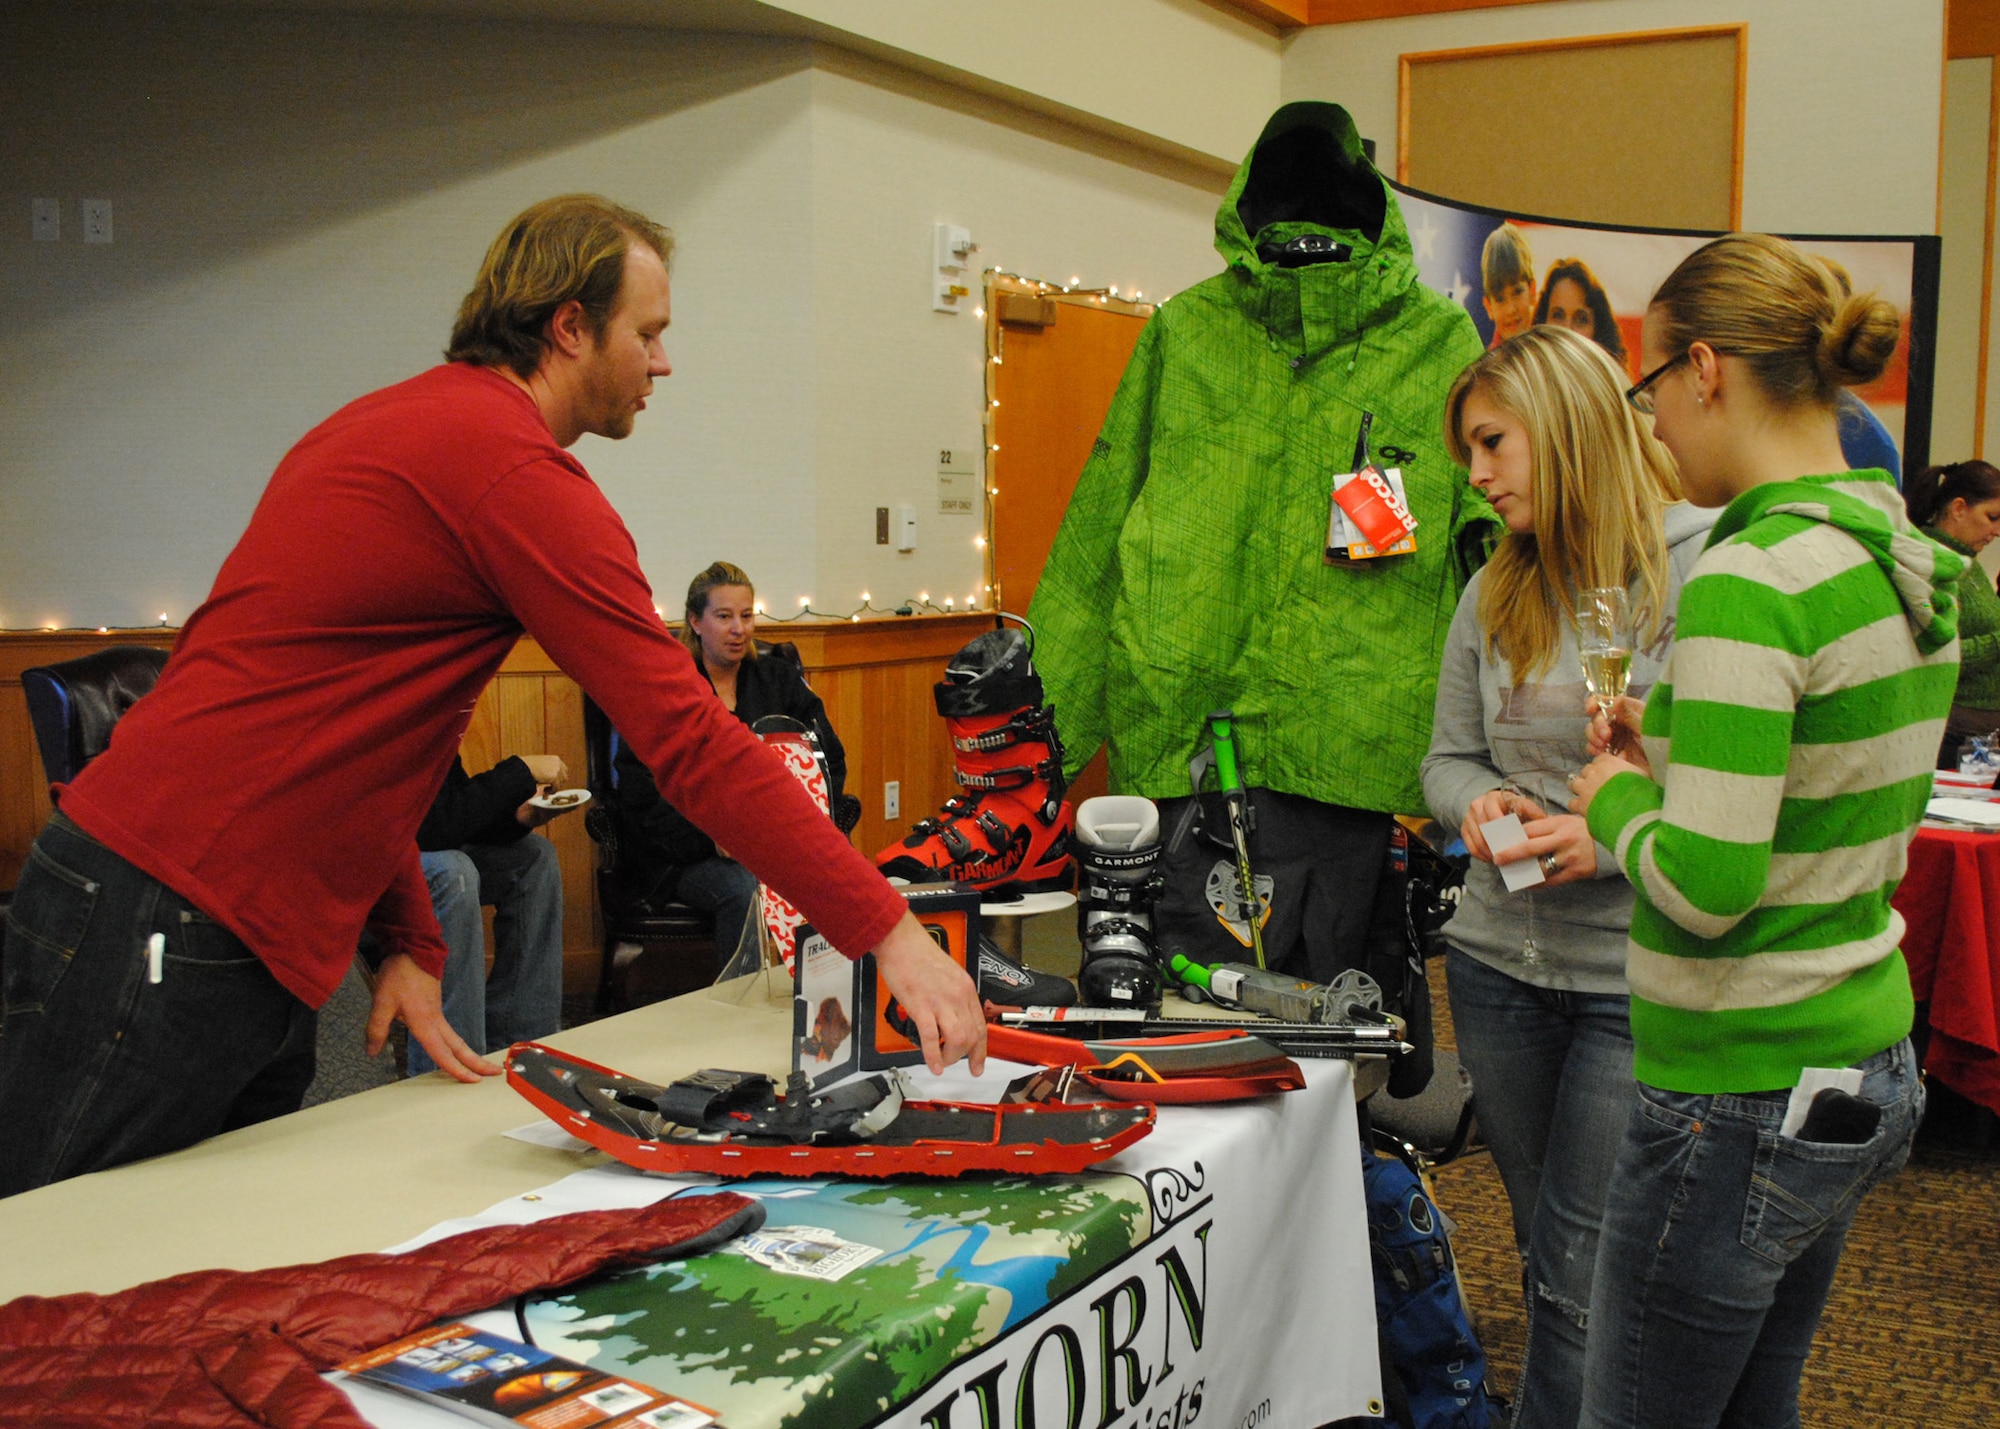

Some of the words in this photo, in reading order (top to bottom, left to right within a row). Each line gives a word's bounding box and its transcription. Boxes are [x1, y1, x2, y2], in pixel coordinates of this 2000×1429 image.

[940, 450, 952, 464] 22
[1367, 471, 1419, 532] RECCO
[949, 838, 1024, 882] GARMONT
[1094, 851, 1160, 866] GARMONT
